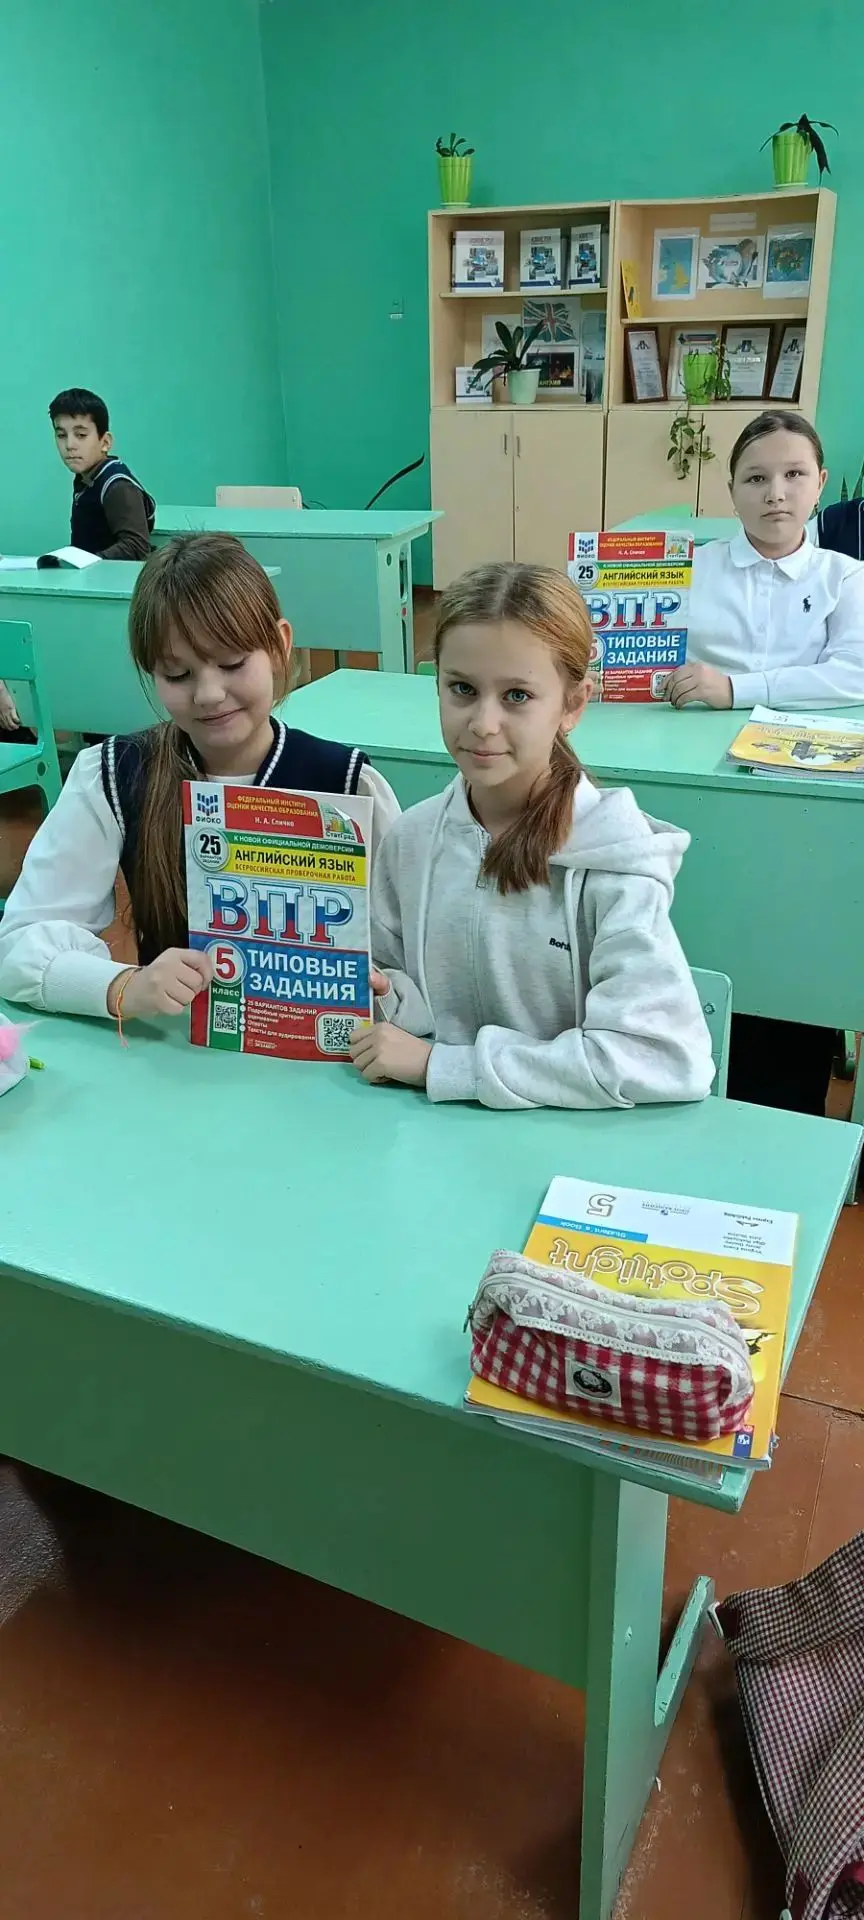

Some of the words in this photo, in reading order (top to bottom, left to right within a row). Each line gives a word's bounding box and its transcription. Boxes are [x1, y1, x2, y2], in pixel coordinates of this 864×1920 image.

[578, 565, 594, 579] 25
[602, 569, 658, 580] АНГЛИЙСКИЙ
[660, 570, 684, 579] ЯЗЫК
[606, 635, 681, 649] ТИПОВЫЕ
[607, 650, 678, 666] ЗАДАНИЯ
[237, 795, 280, 806] ФЕДЕРАЛЬНЫЙ
[227, 803, 250, 811] ОЦЕНКИ
[250, 804, 279, 813] КАЧЕСТВА
[279, 807, 319, 817] ОБРАЗОВАНИЯ
[199, 833, 221, 856] 25
[239, 836, 261, 844] НОВОЙ
[262, 837, 311, 848] ОФИЦИАЛЬНОЙ
[311, 843, 354, 853] ДЕМОВЕРСИИ
[235, 849, 316, 869] АНГЛИЙСКИЙ
[318, 857, 355, 873] ЯЗЫК
[235, 863, 285, 875] ВСЕРОССИЙСКАЯ
[285, 867, 331, 879] ПРОВЕРОЧНАЯ
[332, 874, 357, 882] РАБОТА
[204, 875, 354, 947] ВПР
[215, 947, 236, 980] 5
[247, 949, 358, 979] ТИПОВЫЕ
[212, 987, 240, 997] класс
[249, 972, 356, 1002] ЗАДАНИЯ
[254, 1001, 288, 1012] ВАРИАНТОВ
[288, 1006, 318, 1016] ЗАДАНИЙ
[586, 1193, 617, 1218] 5
[549, 1237, 765, 1316] Spotlight
